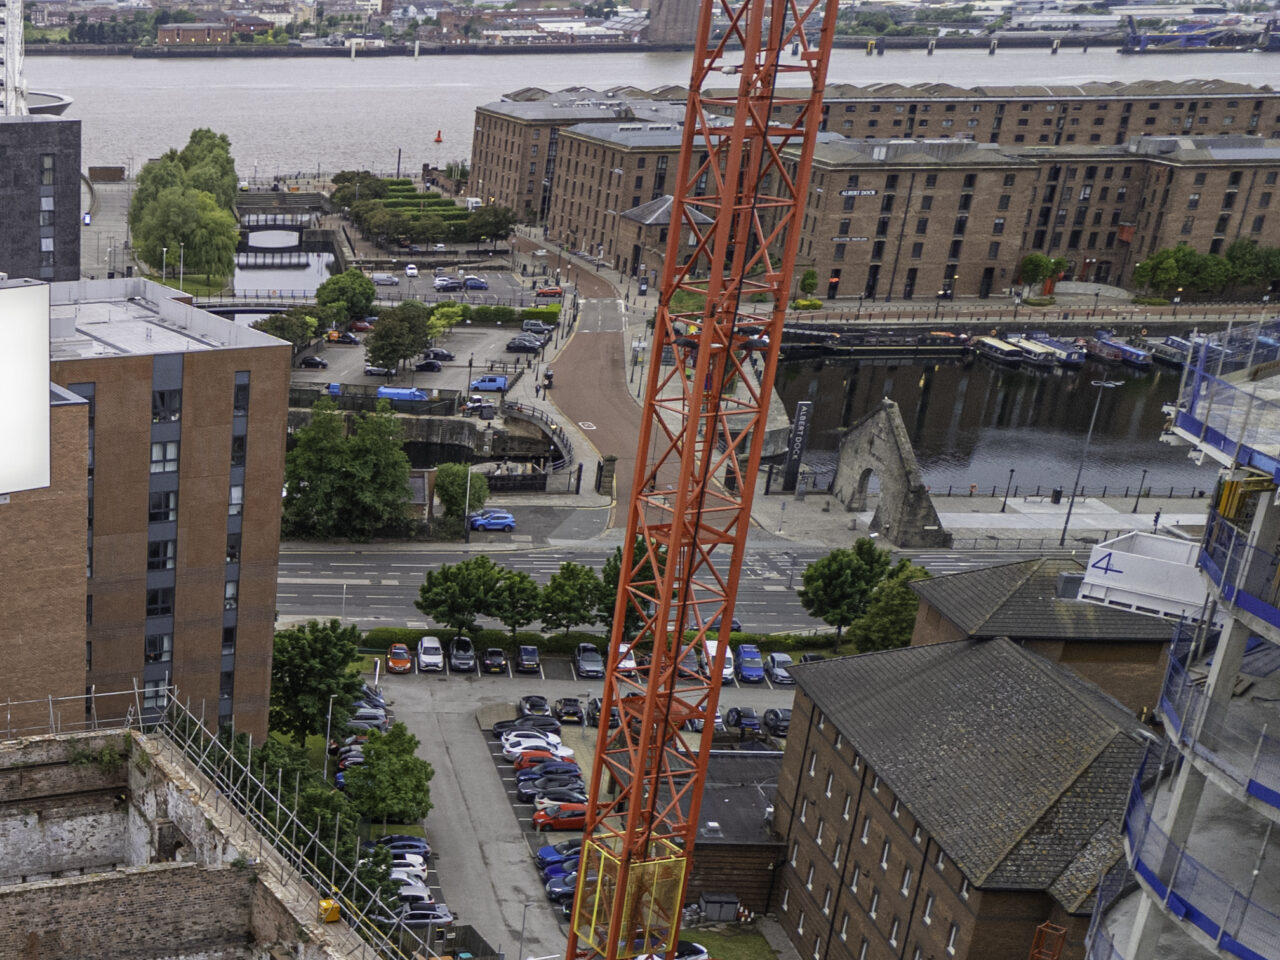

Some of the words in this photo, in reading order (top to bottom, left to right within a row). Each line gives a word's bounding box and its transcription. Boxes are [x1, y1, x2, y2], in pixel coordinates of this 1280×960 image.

[796, 405, 808, 436] ALBERT
[791, 436, 803, 460] DOCK
[1091, 552, 1124, 575] 4
